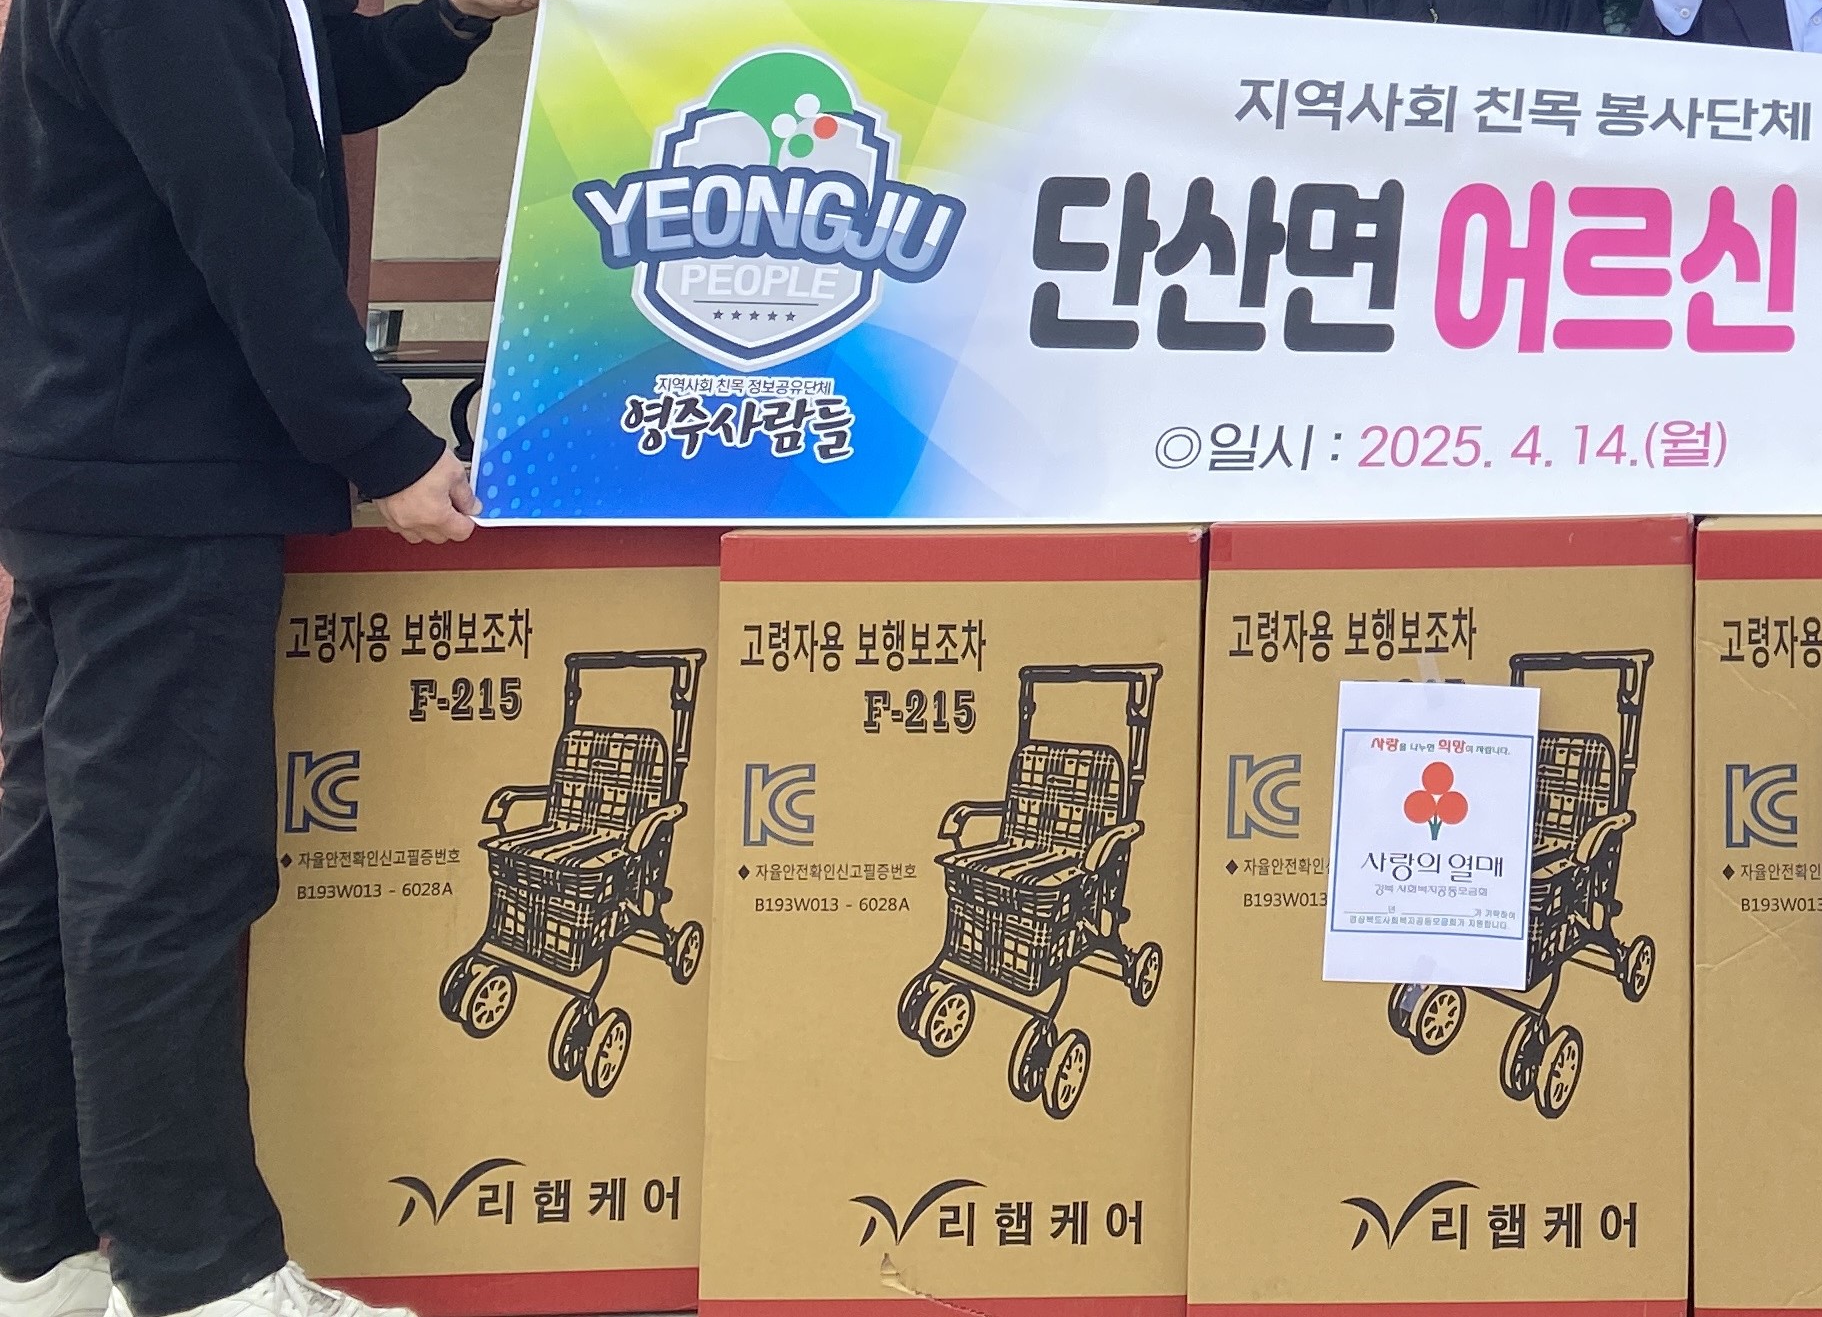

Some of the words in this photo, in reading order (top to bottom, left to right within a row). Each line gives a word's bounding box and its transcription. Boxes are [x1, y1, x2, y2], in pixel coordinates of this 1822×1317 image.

[1234, 78, 1459, 134] 지역사회
[1473, 85, 1583, 136] 친목
[1595, 93, 1813, 142] 봉사단체
[585, 174, 952, 273] YEONGJU
[679, 262, 839, 301] PEOPLE
[1029, 171, 1405, 353] 단산면
[1434, 180, 1798, 354] 어르신
[657, 377, 712, 394] 지역사회
[716, 378, 744, 393] 친목
[748, 379, 831, 395] 정보공유단체
[624, 396, 852, 460] 영주사람들
[1357, 424, 1493, 469] 2025.
[1510, 425, 1553, 468] 4.
[1575, 420, 1728, 469] 14.(월)
[285, 612, 391, 663] 고령자용
[401, 608, 533, 661] 보행보조차
[740, 619, 844, 672] 고령자용
[855, 619, 986, 672] 보행보조차
[1228, 609, 1333, 663] 고령자용
[1344, 606, 1477, 661] 보행보조차
[409, 677, 522, 722] F-215
[863, 689, 977, 735] F-215
[284, 750, 360, 834] KC
[742, 763, 816, 847] KC
[1226, 753, 1302, 839] KC
[1725, 764, 1798, 848] KC
[298, 848, 461, 870] 자율안전확인신고필증번호
[754, 863, 917, 881] 자율안전확인신고필증번호
[1360, 852, 1441, 882] 사랑의
[1449, 853, 1504, 883] 열매
[297, 884, 382, 901] B193W013
[402, 882, 453, 898] 6028A
[754, 896, 840, 913] B193W013
[859, 895, 910, 912] 6028A
[1243, 892, 1328, 907] B193W013
[476, 1174, 682, 1225] 리햅케어
[938, 1199, 1143, 1247] 리햅케어
[1430, 1199, 1640, 1251] 리햅케어
